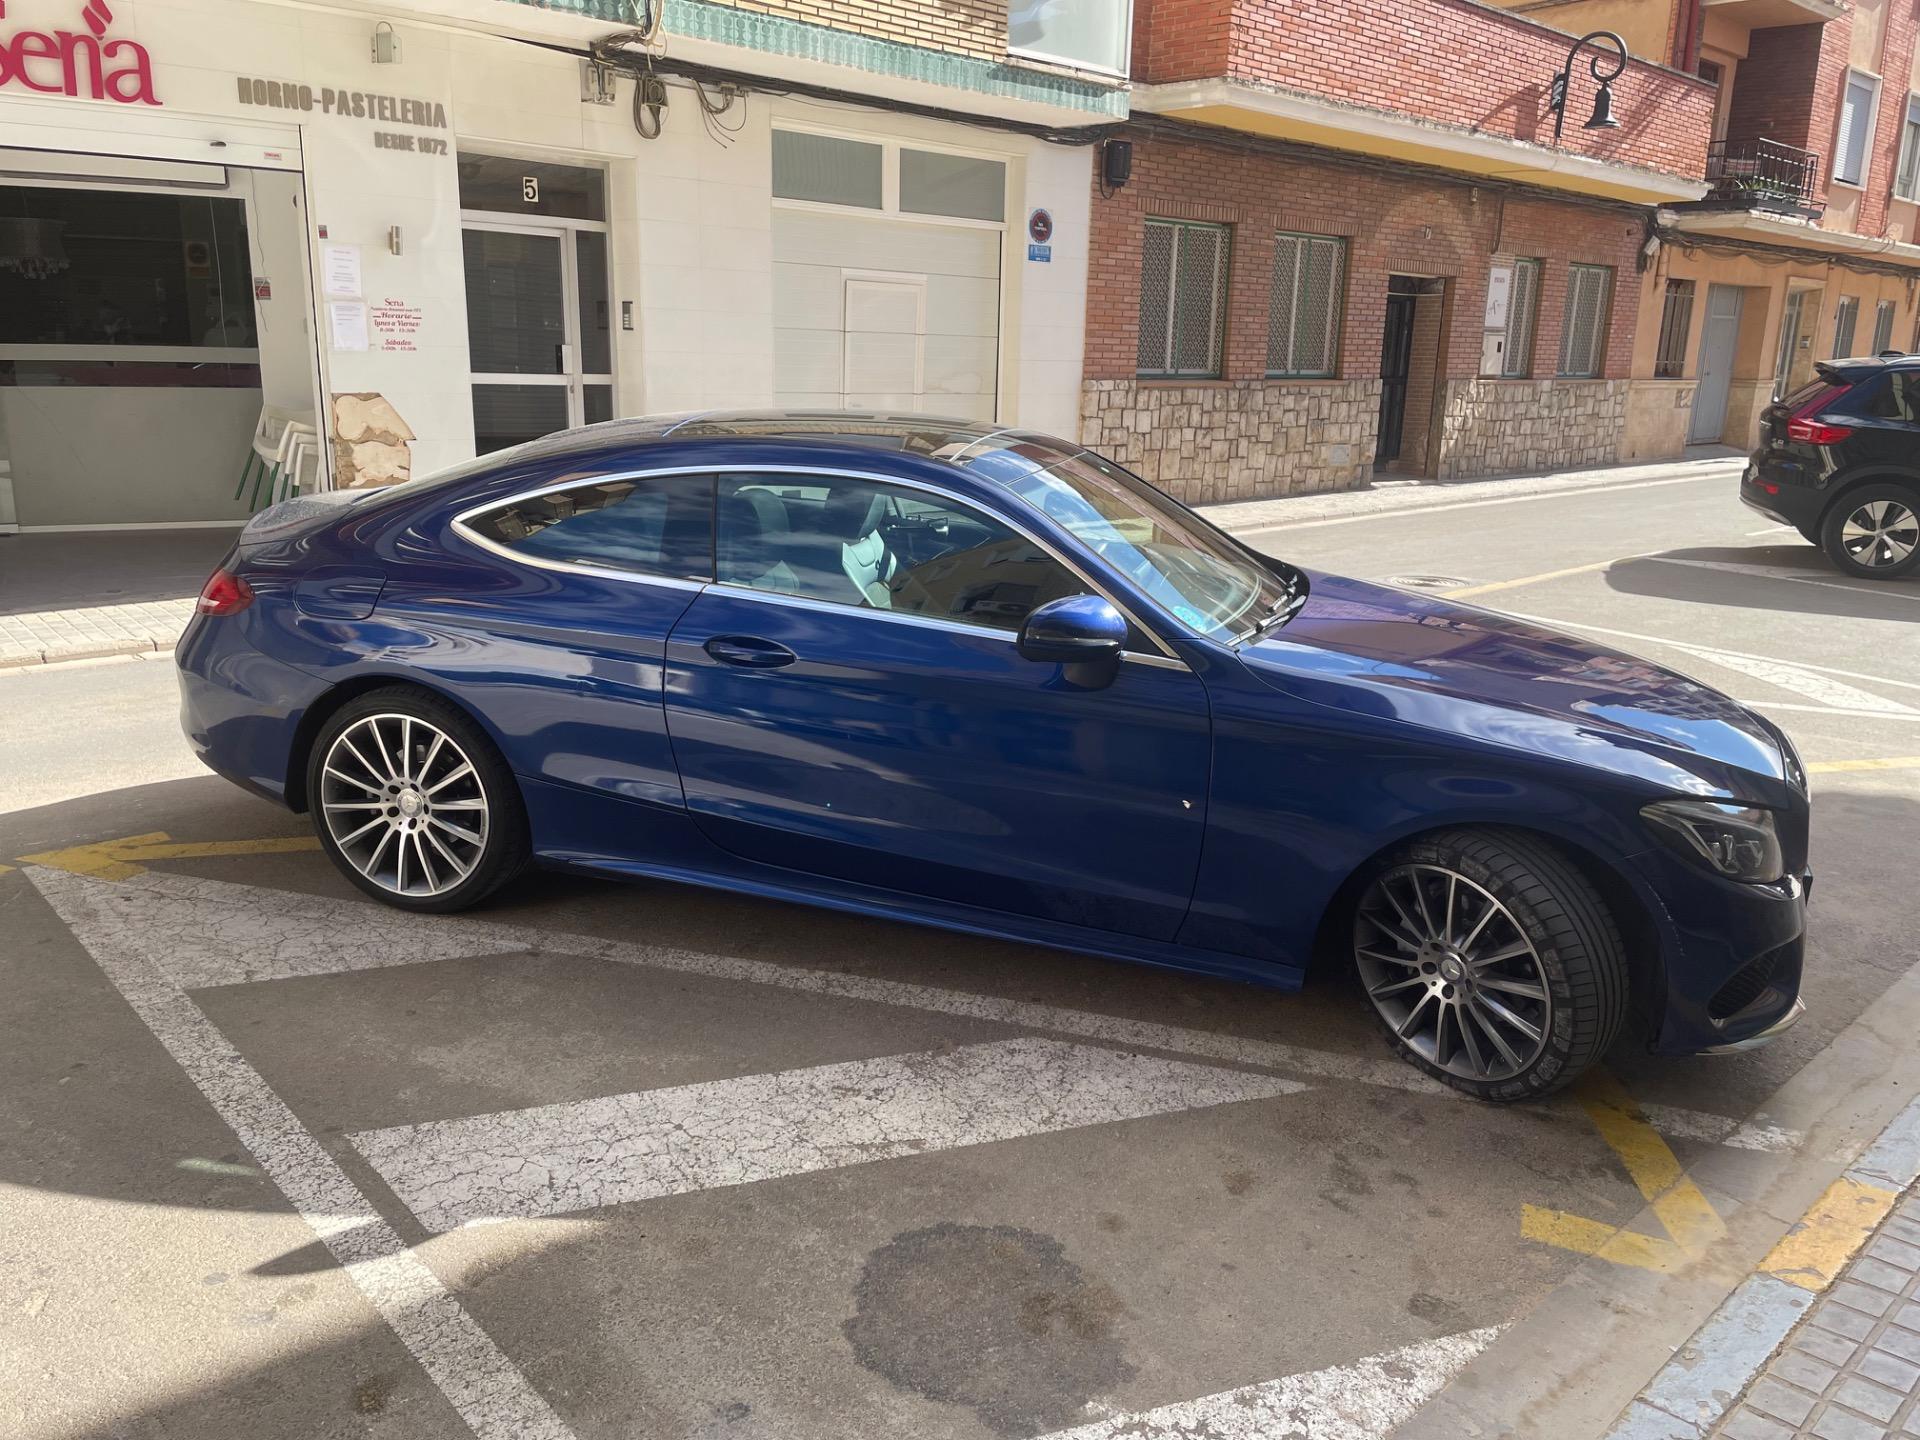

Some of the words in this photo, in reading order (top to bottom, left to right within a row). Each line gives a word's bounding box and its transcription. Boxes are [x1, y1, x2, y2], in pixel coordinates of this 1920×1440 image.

[0, 0, 163, 105] ena
[237, 77, 447, 129] HORNO-PASTELERIA
[374, 131, 415, 152] DESDE
[525, 178, 536, 200] 5
